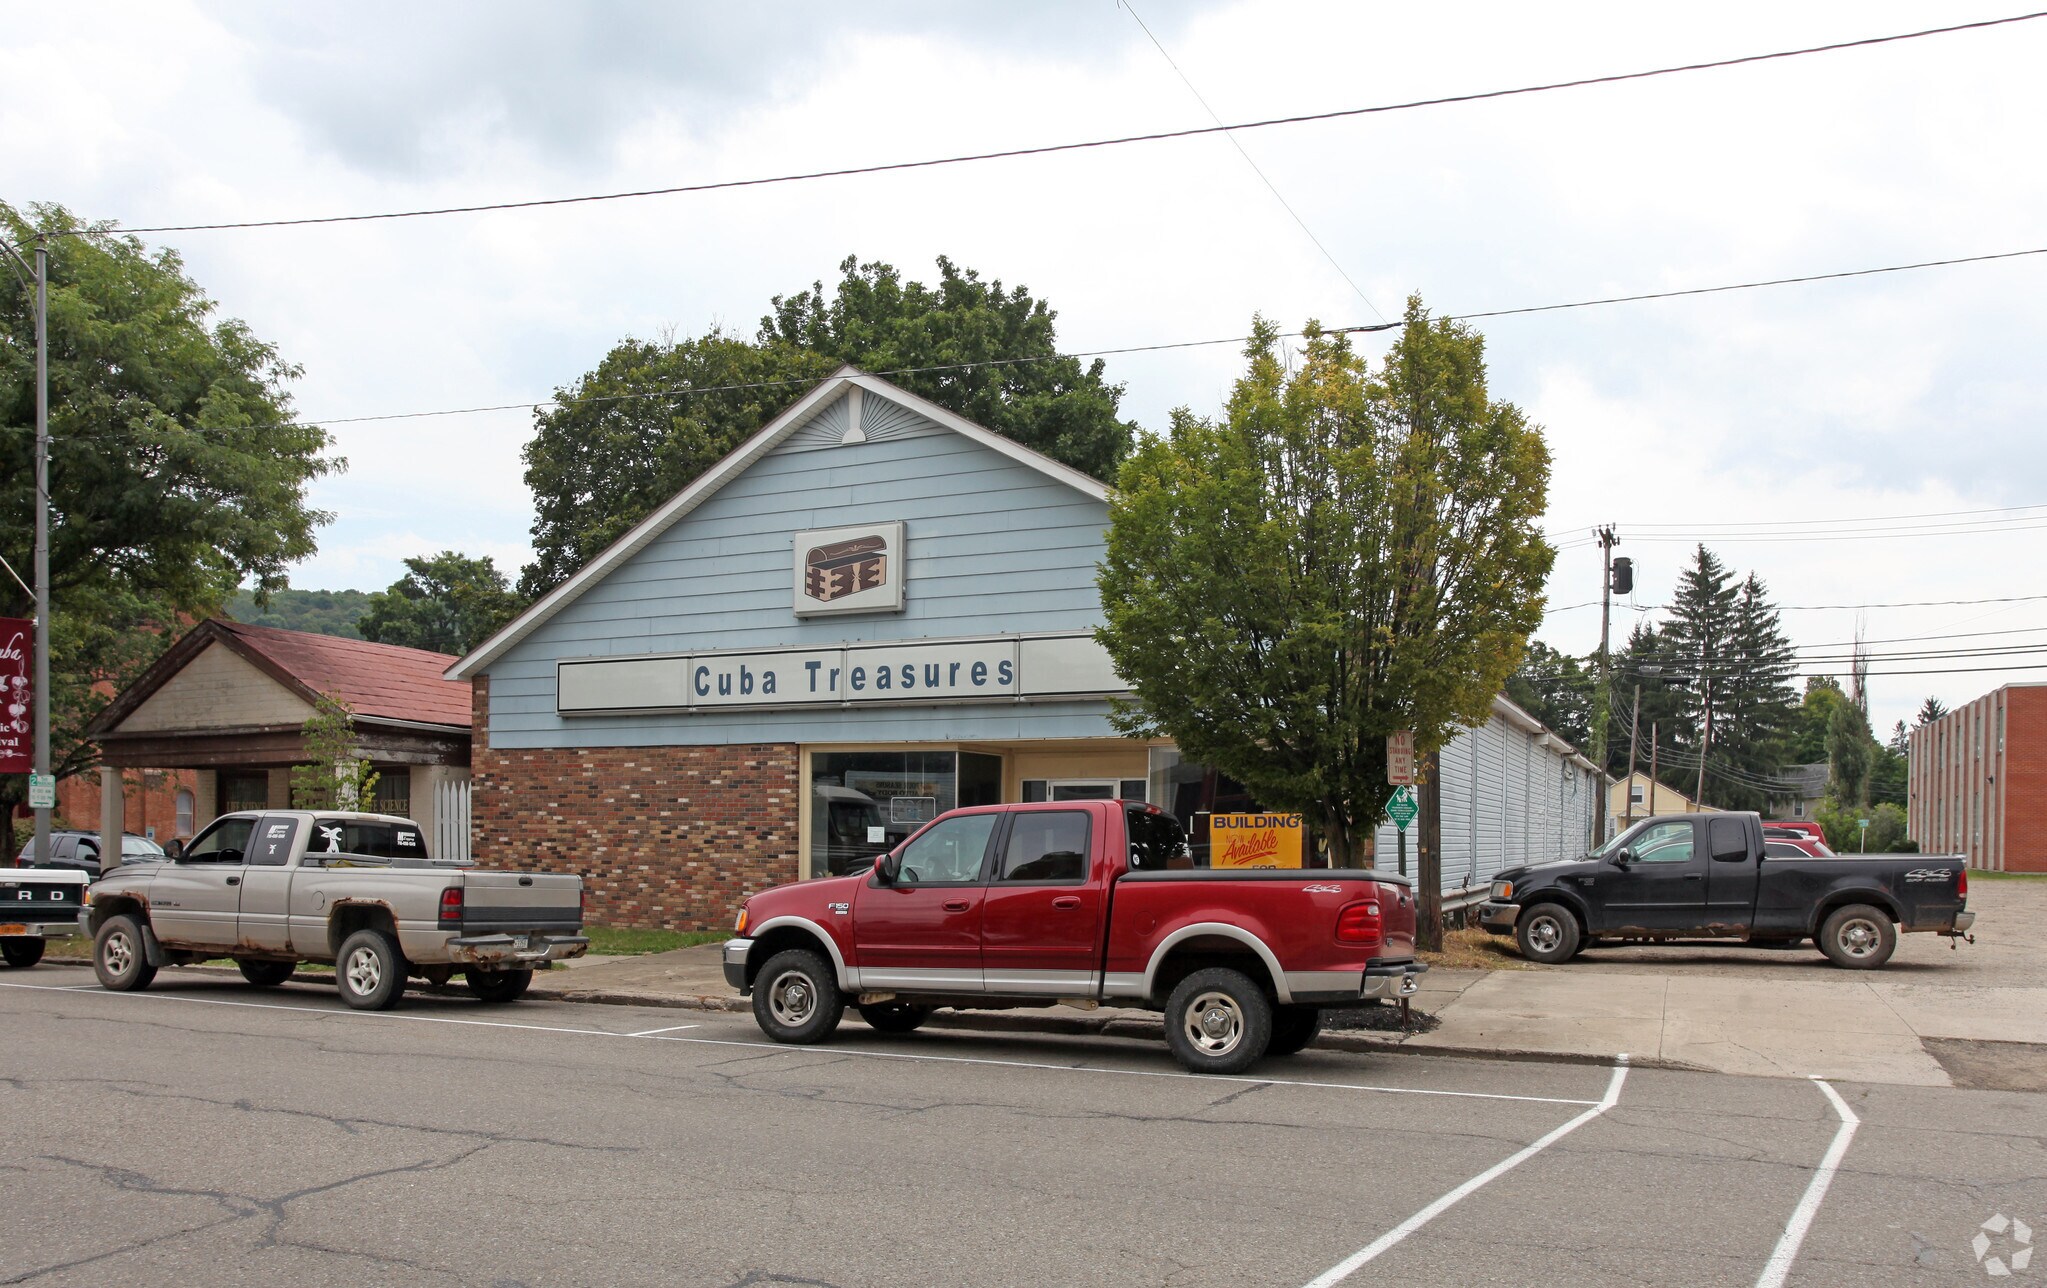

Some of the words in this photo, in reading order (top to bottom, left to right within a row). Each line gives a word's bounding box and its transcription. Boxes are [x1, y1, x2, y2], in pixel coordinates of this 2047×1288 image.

[0, 632, 24, 660] ba
[694, 664, 777, 697] Cuba
[805, 660, 1014, 693] Treasures
[1394, 736, 1405, 746] NO
[1389, 747, 1411, 755] STANDING
[1394, 766, 1407, 774] TIME
[31, 776, 37, 786] 2
[381, 799, 408, 811] SCIENCE
[1213, 816, 1300, 829] BUILDING
[1221, 829, 1279, 865] Available
